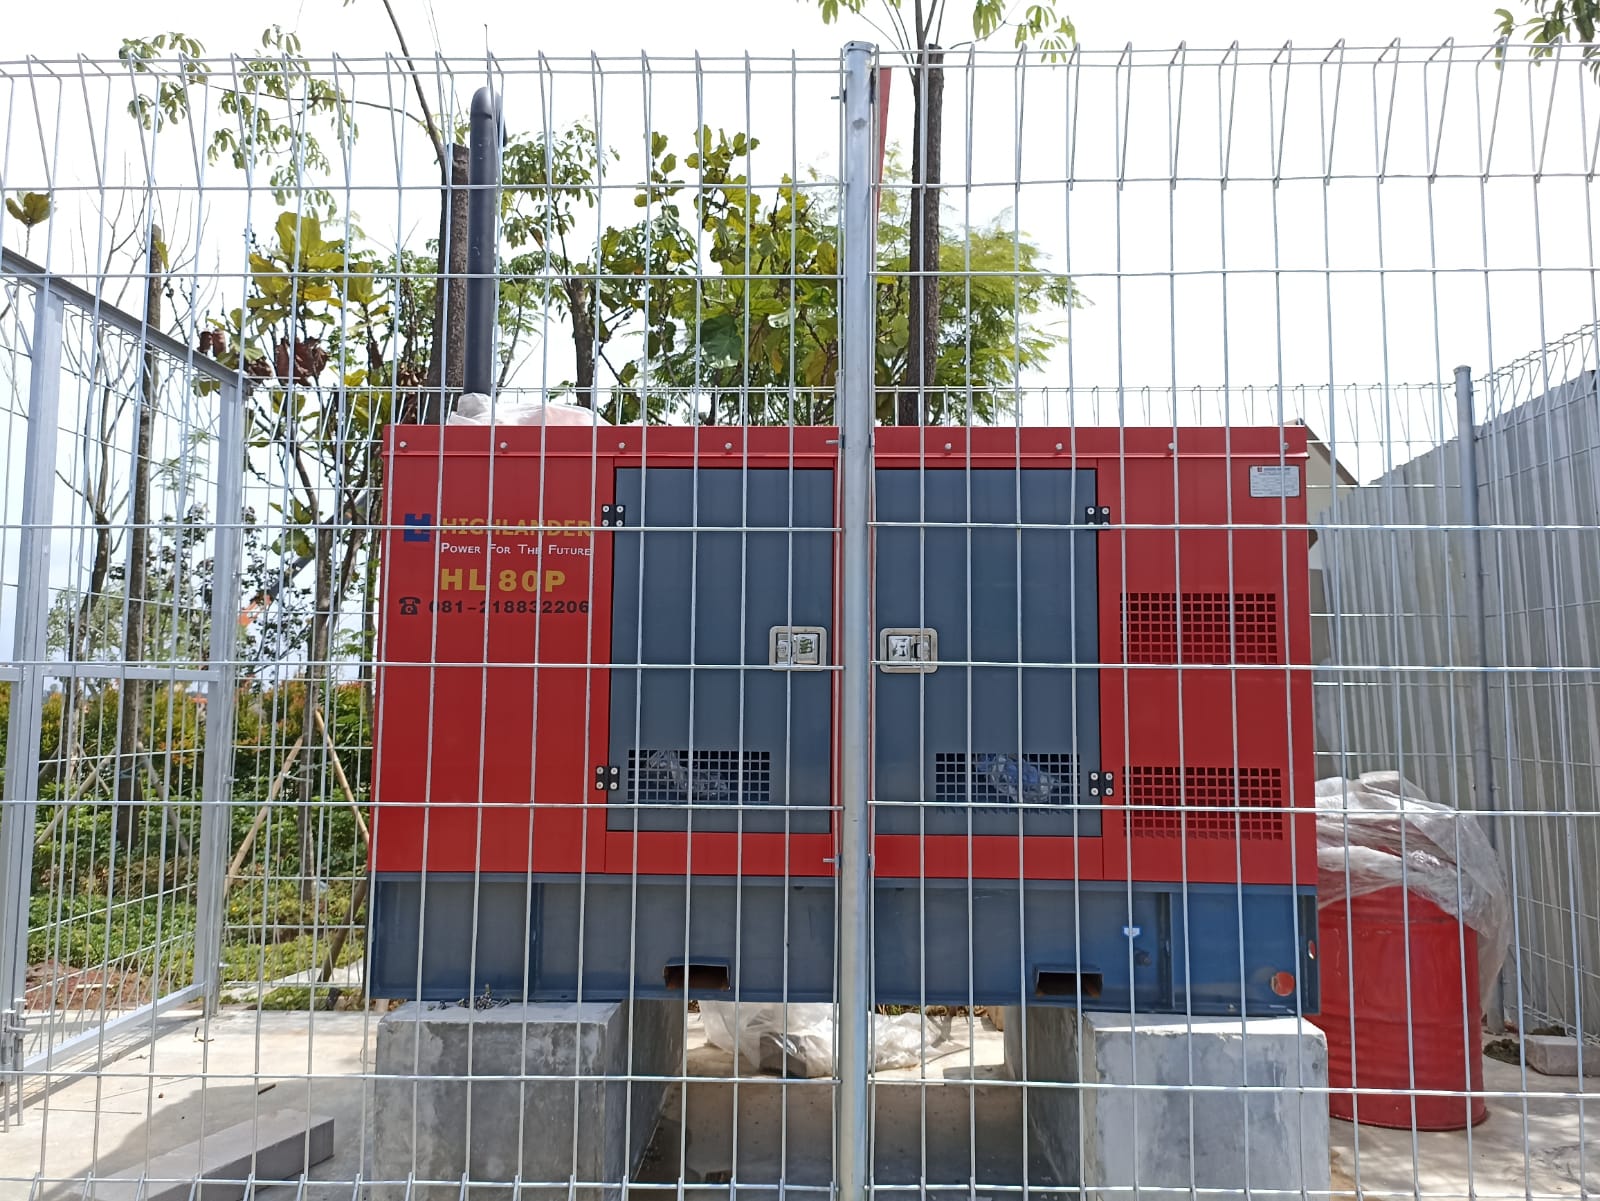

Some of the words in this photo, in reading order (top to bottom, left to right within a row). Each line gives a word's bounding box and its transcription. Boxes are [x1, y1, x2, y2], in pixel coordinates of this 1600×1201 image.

[442, 517, 592, 537] HIGHLANDER
[440, 542, 481, 553] POWER
[490, 543, 511, 554] FOR
[548, 544, 592, 556] FUTURE
